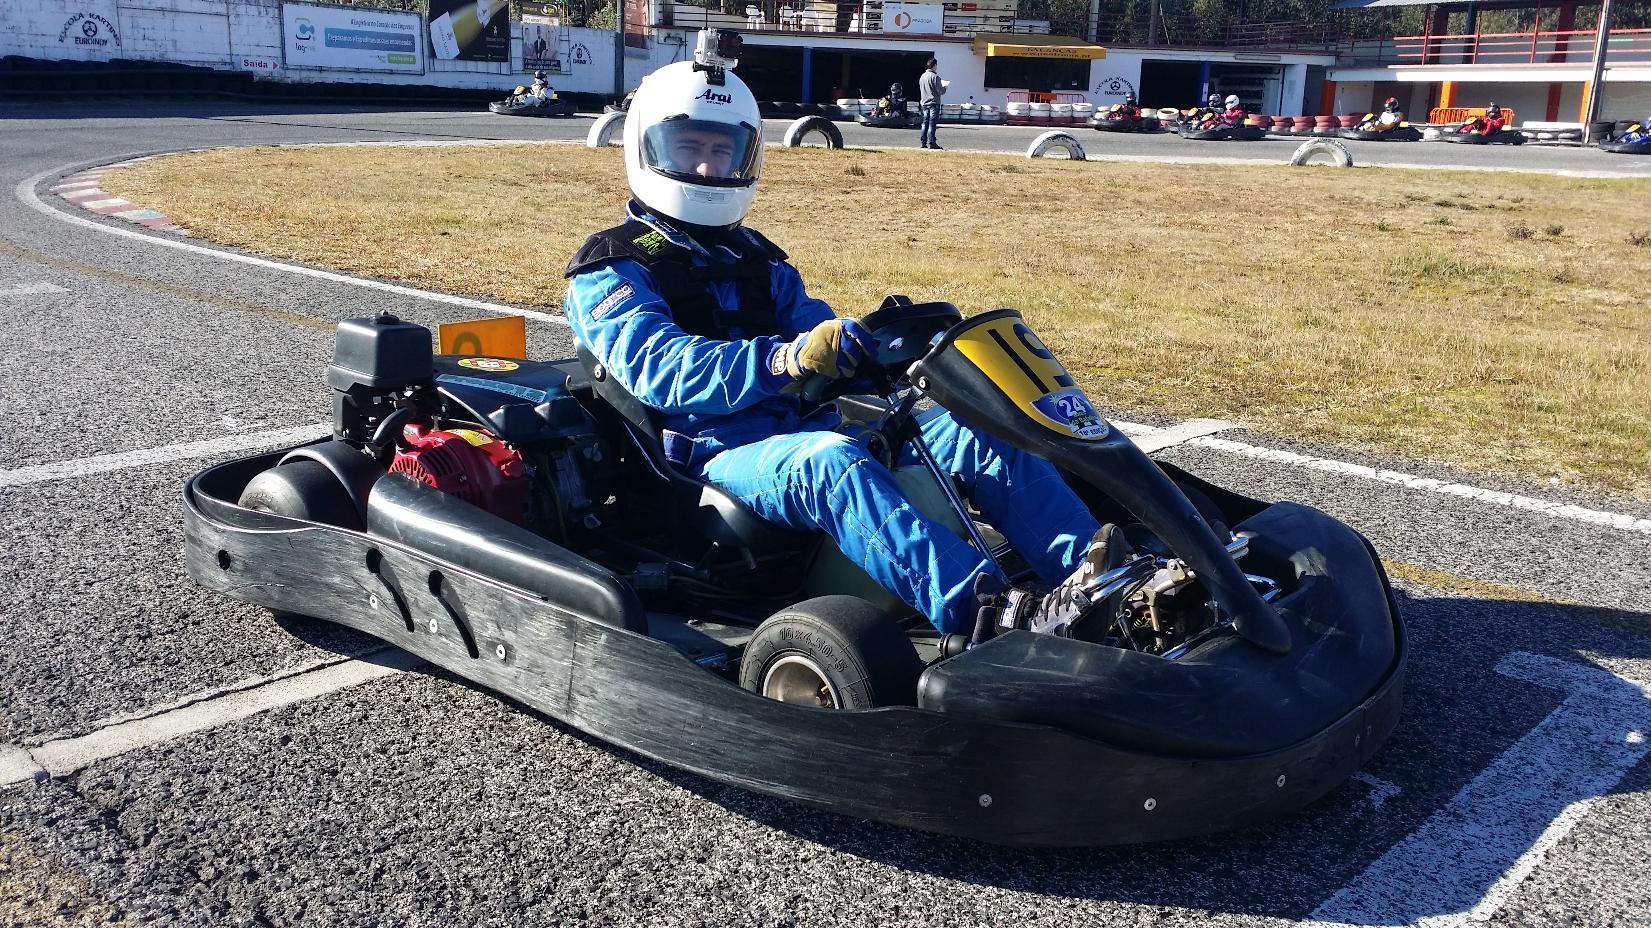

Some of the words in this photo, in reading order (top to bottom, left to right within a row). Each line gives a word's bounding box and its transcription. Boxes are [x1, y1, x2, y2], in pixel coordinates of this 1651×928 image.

[58, 12, 85, 43] ESCOLA
[89, 12, 120, 47] KARTING
[694, 88, 733, 104] Arai
[986, 322, 1075, 395] 19
[1058, 396, 1086, 417] 24
